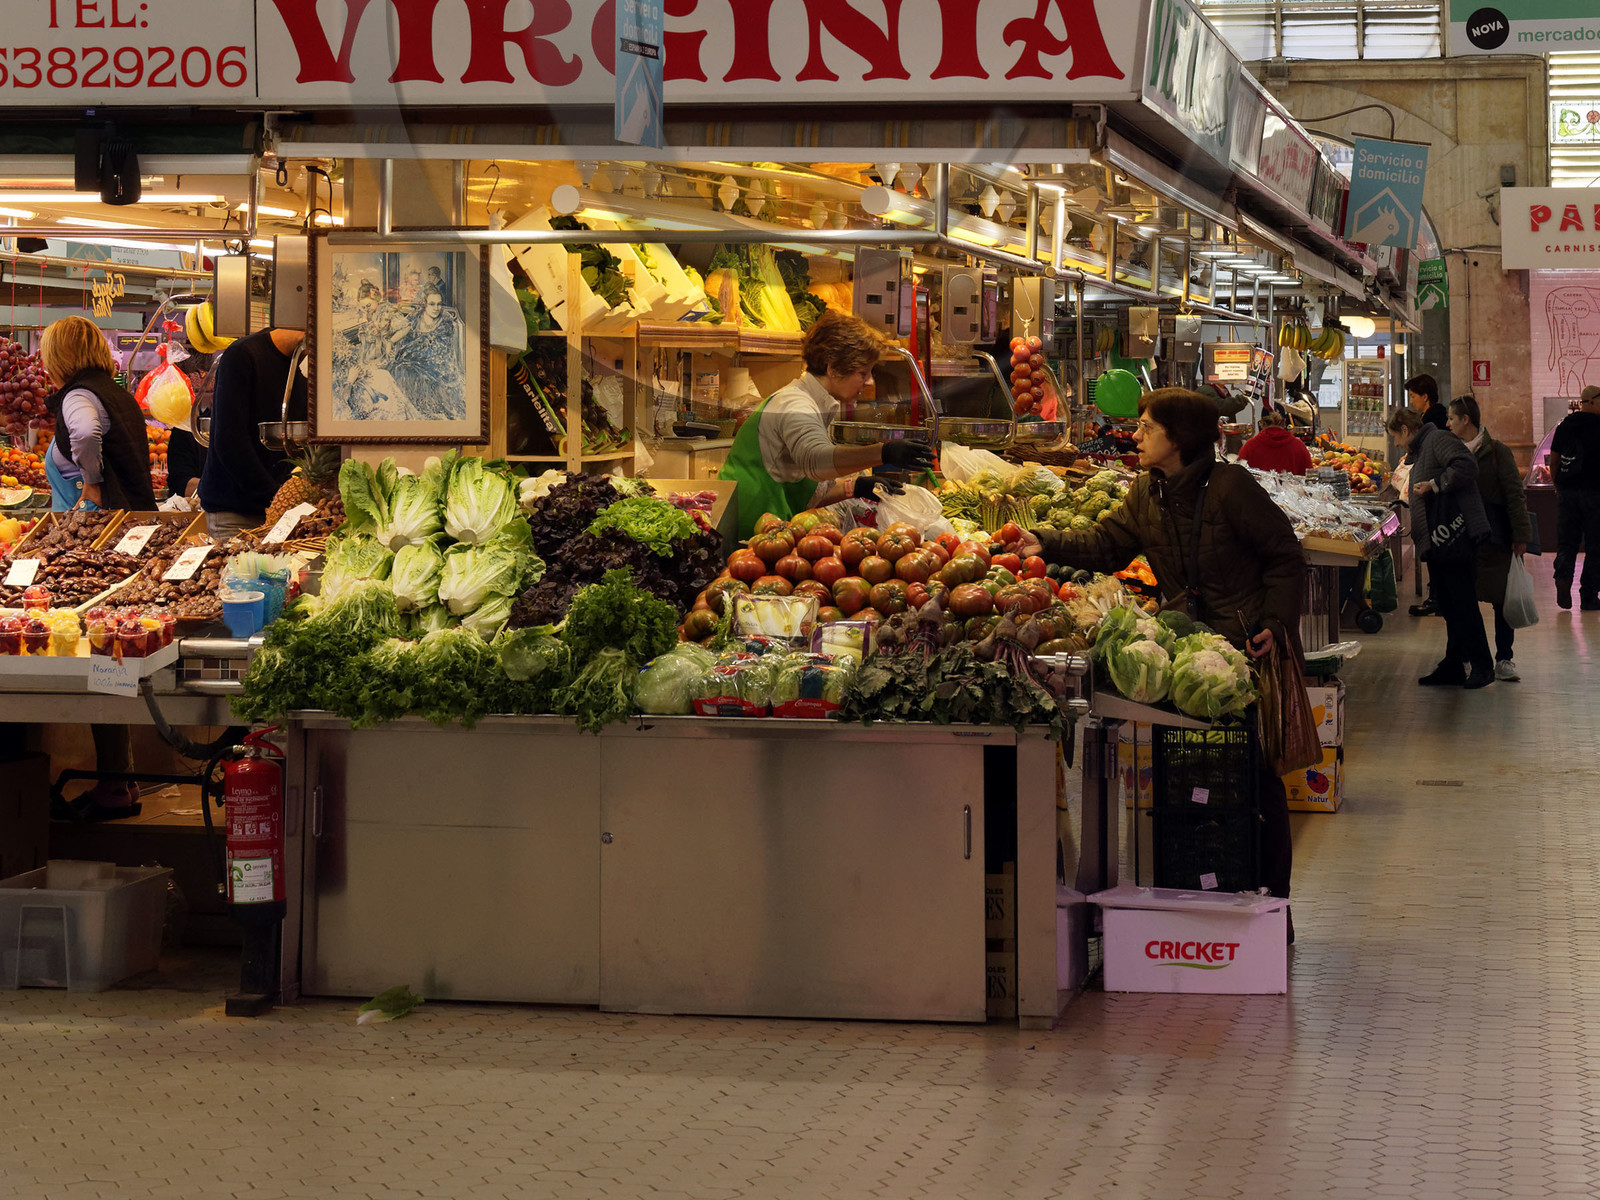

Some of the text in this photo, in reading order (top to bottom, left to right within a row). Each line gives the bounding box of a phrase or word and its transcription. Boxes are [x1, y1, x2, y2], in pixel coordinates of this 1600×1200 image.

[1471, 20, 1504, 37] NOVA
[1358, 149, 1424, 170] Servicio a
[1358, 165, 1421, 185] domicilio
[1530, 204, 1600, 232] PA
[92, 663, 128, 678] Naranja
[1307, 795, 1329, 804] Natur
[1145, 940, 1240, 962] CRICKET
